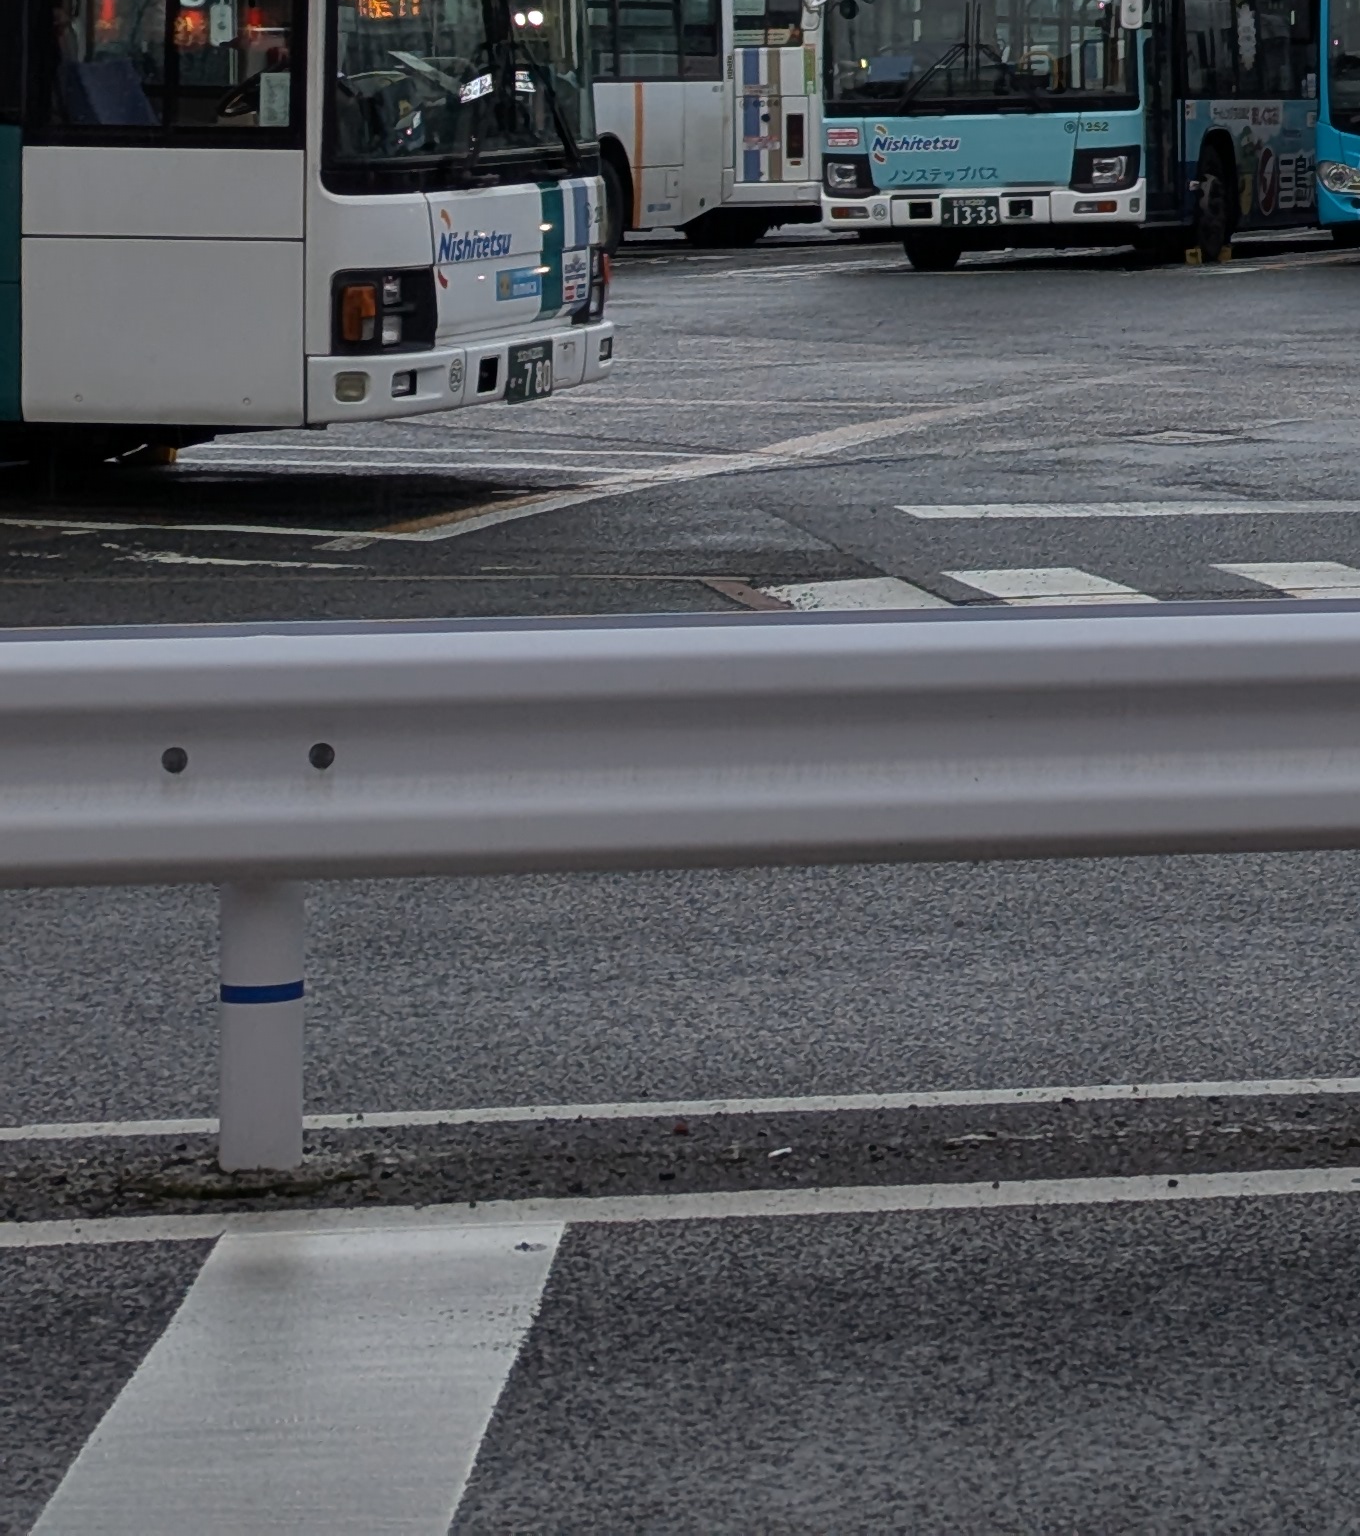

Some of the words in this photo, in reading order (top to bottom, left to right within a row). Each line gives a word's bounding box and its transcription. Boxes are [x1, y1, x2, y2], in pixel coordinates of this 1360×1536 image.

[872, 136, 961, 152] Nishitetsu
[888, 166, 999, 182] ノンステップバス
[953, 205, 998, 225] 13-33
[438, 229, 512, 262] Nishitetsu
